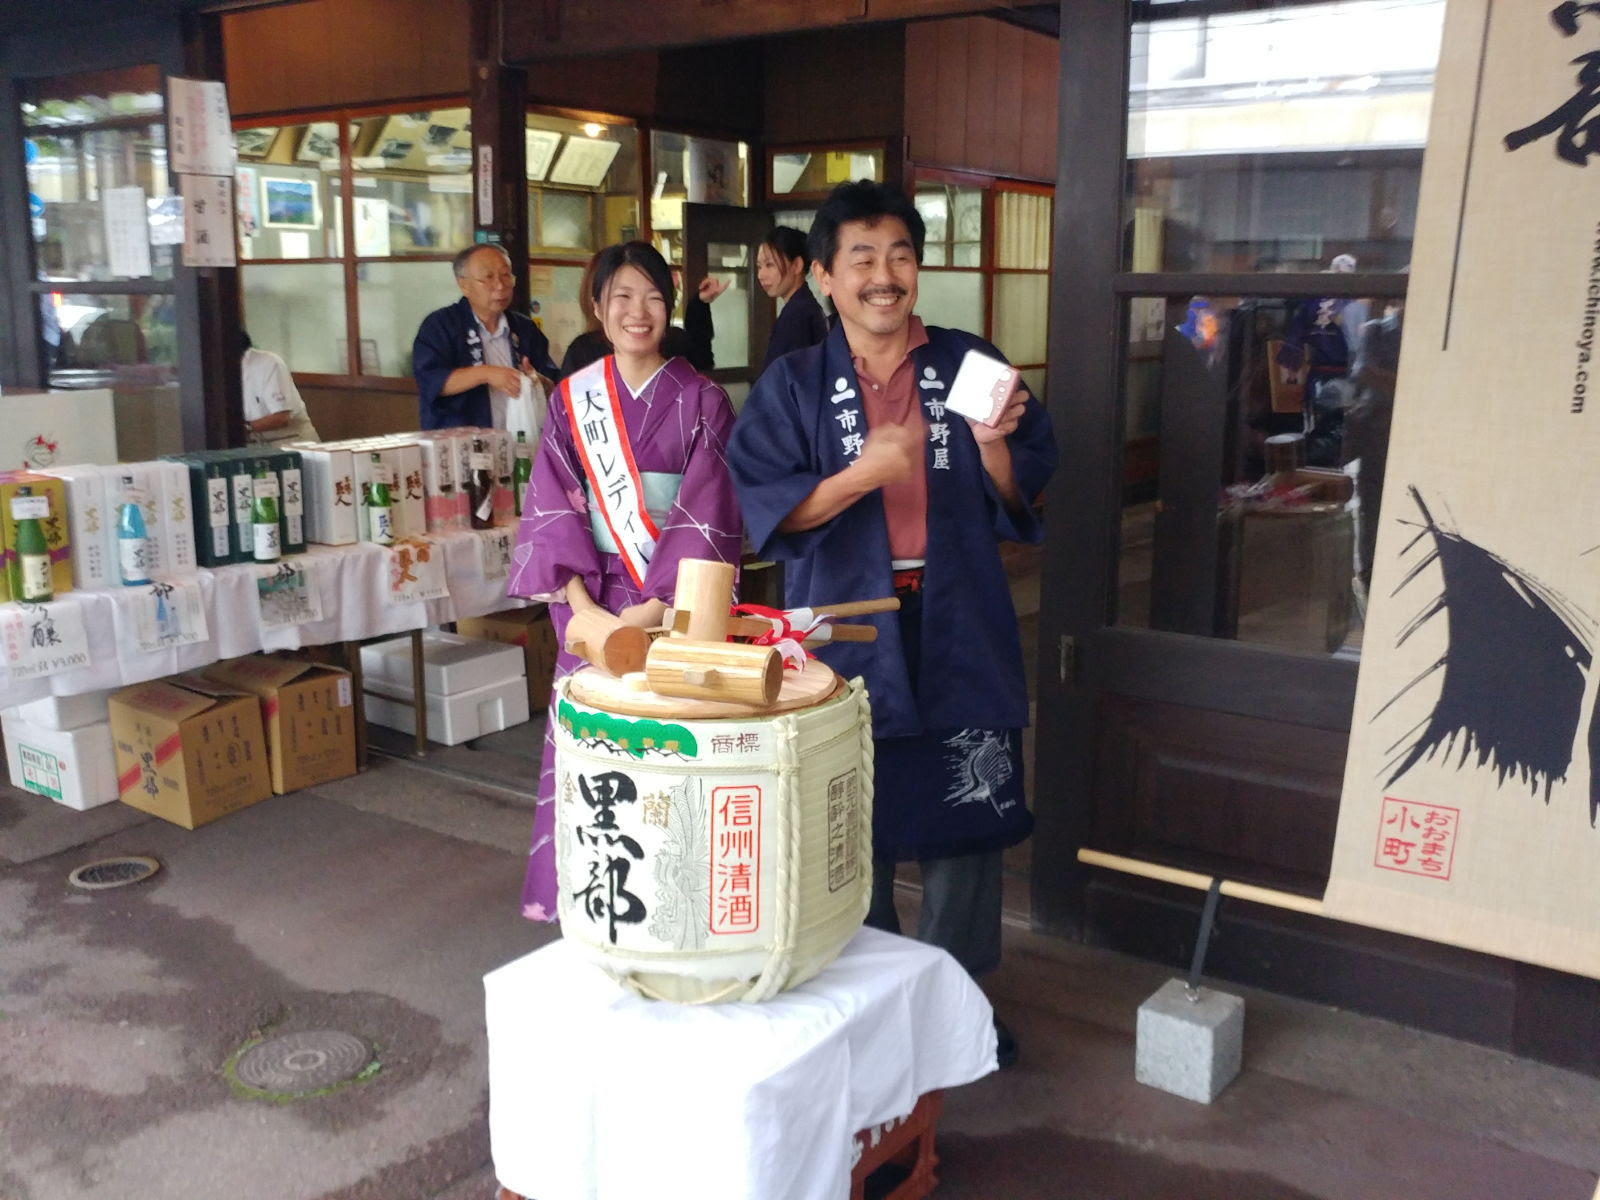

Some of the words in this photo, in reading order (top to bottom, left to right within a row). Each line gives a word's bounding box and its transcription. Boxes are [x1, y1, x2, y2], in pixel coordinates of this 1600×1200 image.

[835, 409, 865, 468] 市野
[924, 398, 951, 471] 市野屋
[711, 733, 760, 754] 商標
[642, 792, 671, 828] 蘭
[1383, 806, 1421, 866] 小町
[573, 770, 647, 944] 黒部
[719, 794, 754, 926] 信州清酒
[1418, 810, 1453, 872] おおまち
